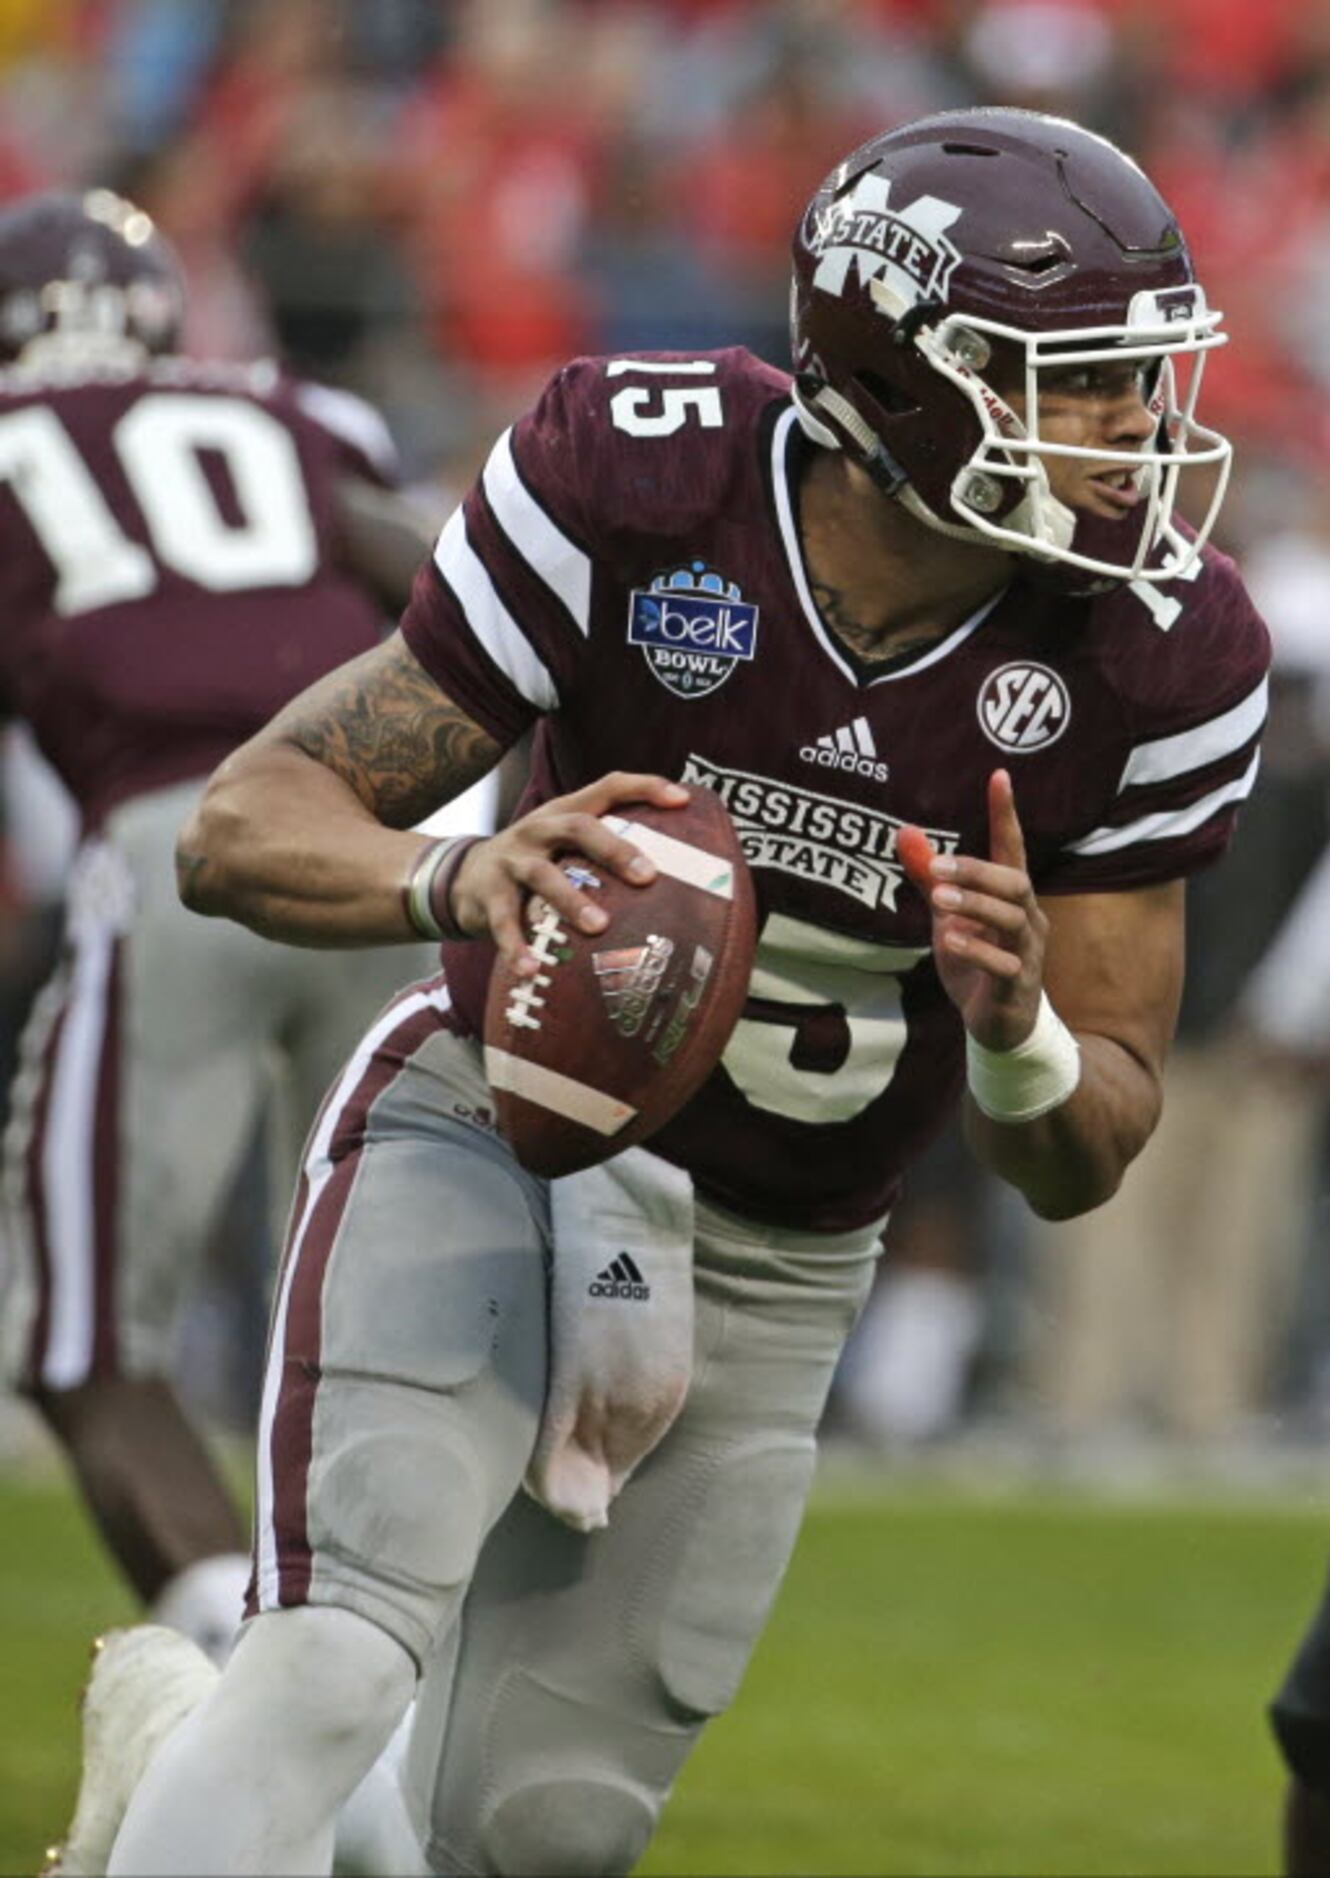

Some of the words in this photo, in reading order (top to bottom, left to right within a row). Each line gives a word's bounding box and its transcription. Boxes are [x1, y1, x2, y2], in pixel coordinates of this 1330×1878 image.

[832, 211, 930, 277] STATE
[606, 360, 724, 437] 15
[0, 393, 318, 620] 10
[660, 600, 749, 651] belk
[654, 649, 724, 676] BOWL
[986, 668, 1065, 746] SEC
[799, 744, 889, 784] adidas
[741, 834, 870, 896] STATE
[588, 1281, 651, 1302] adidas
